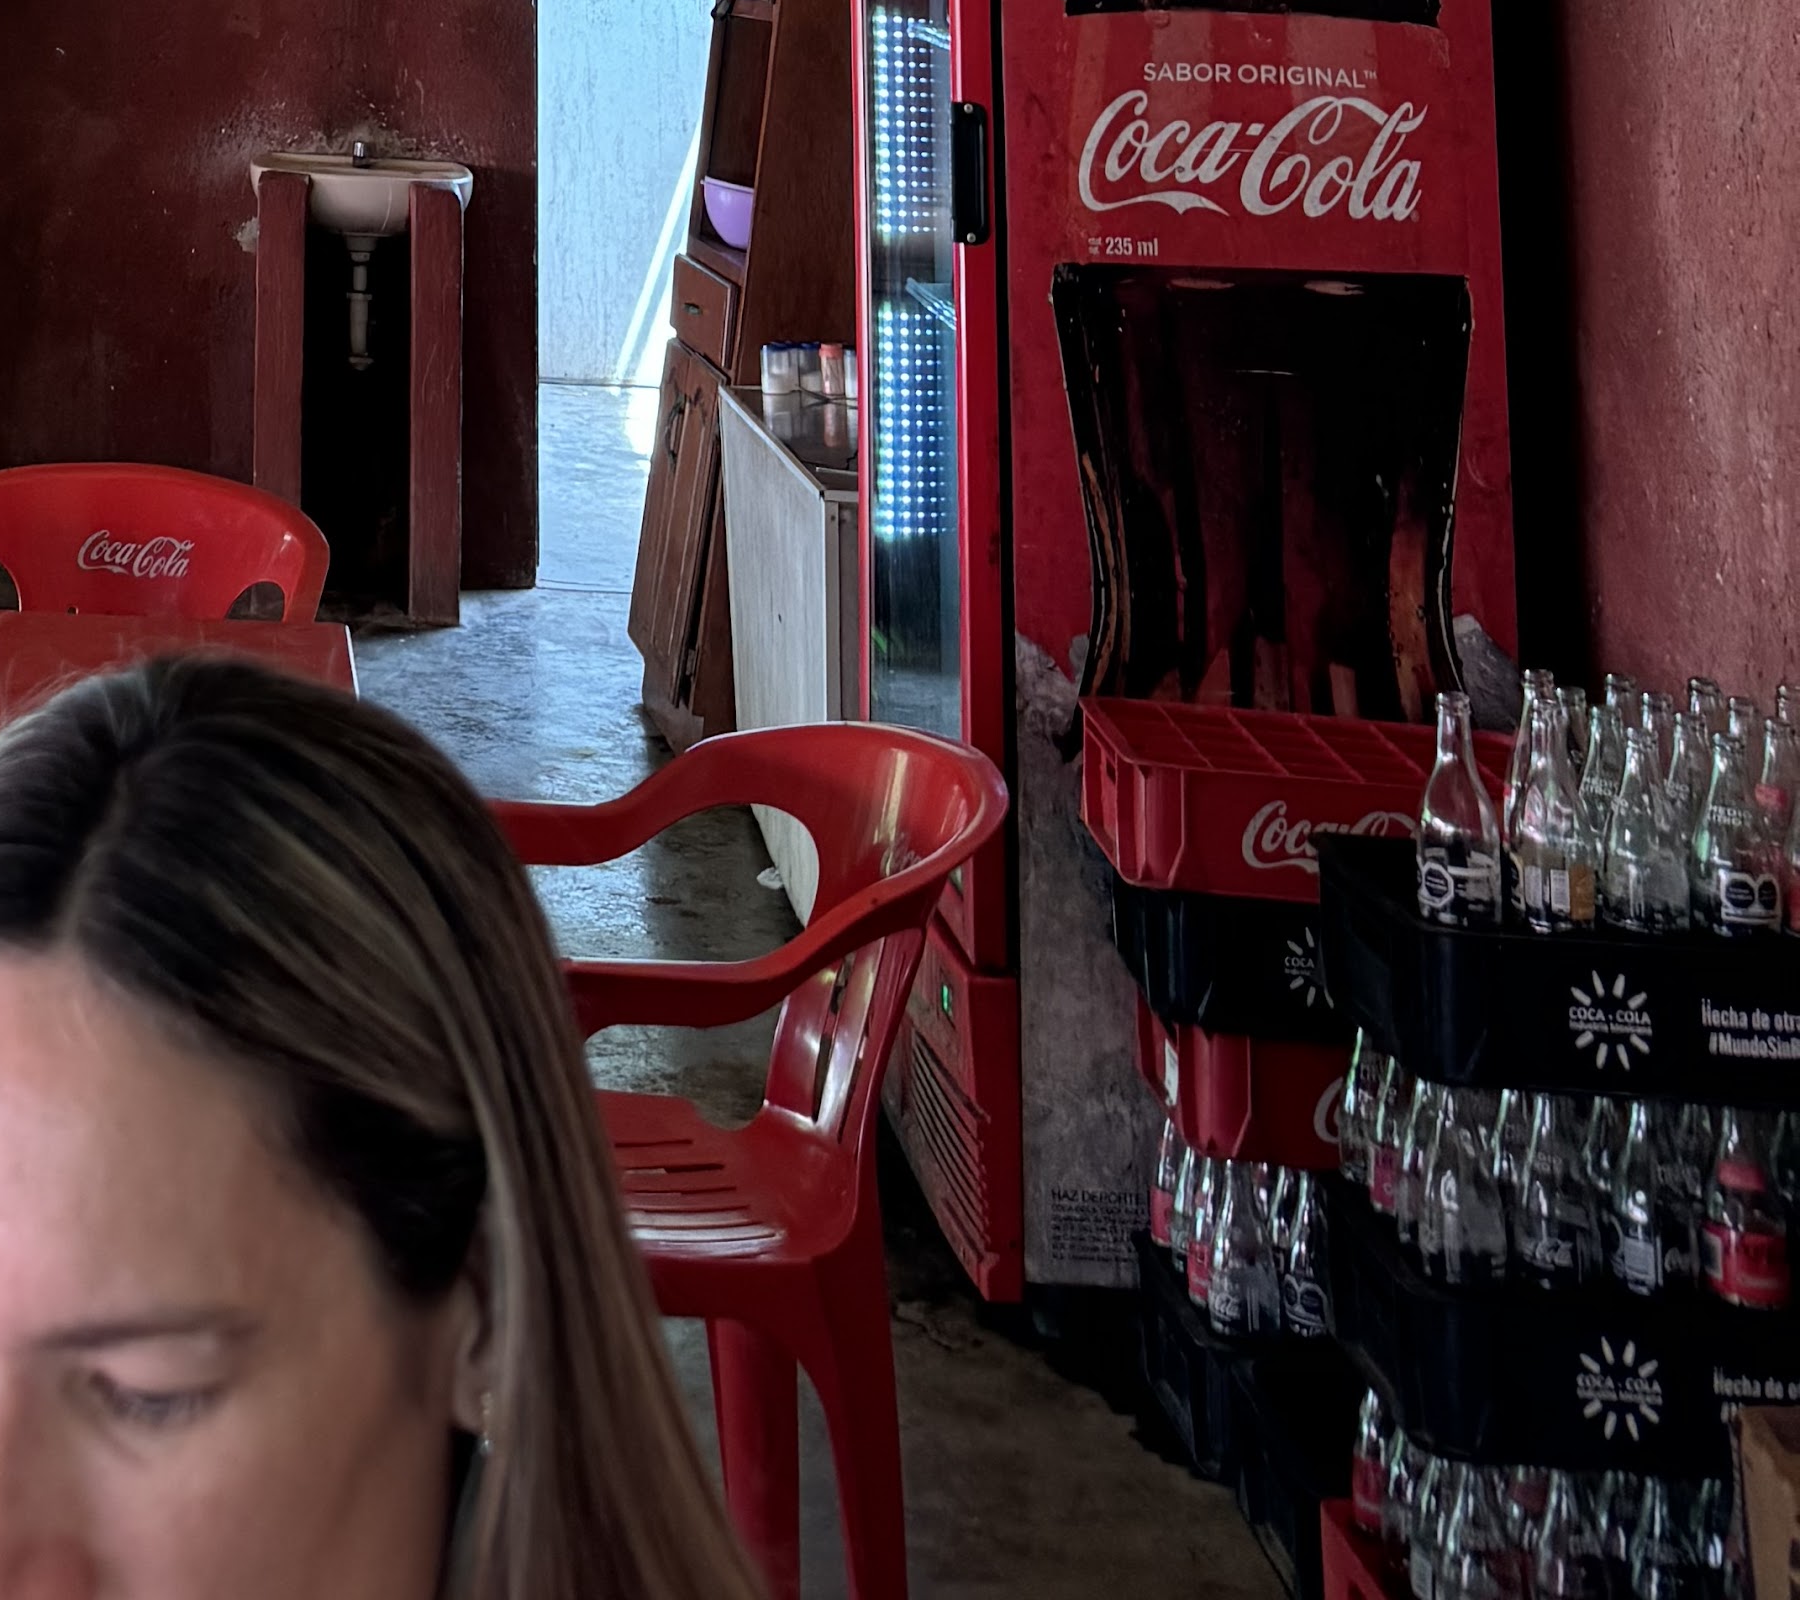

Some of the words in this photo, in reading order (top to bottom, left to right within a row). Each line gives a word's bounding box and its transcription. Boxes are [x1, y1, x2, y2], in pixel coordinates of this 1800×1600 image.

[1143, 62, 1231, 83] SABOR
[1078, 89, 1429, 222] Coca-Cola
[1105, 236, 1133, 255] 235
[1137, 237, 1159, 257] ml
[77, 529, 196, 579] Coca-Cola
[1701, 998, 1748, 1030] Hecha
[1752, 1007, 1770, 1031] de
